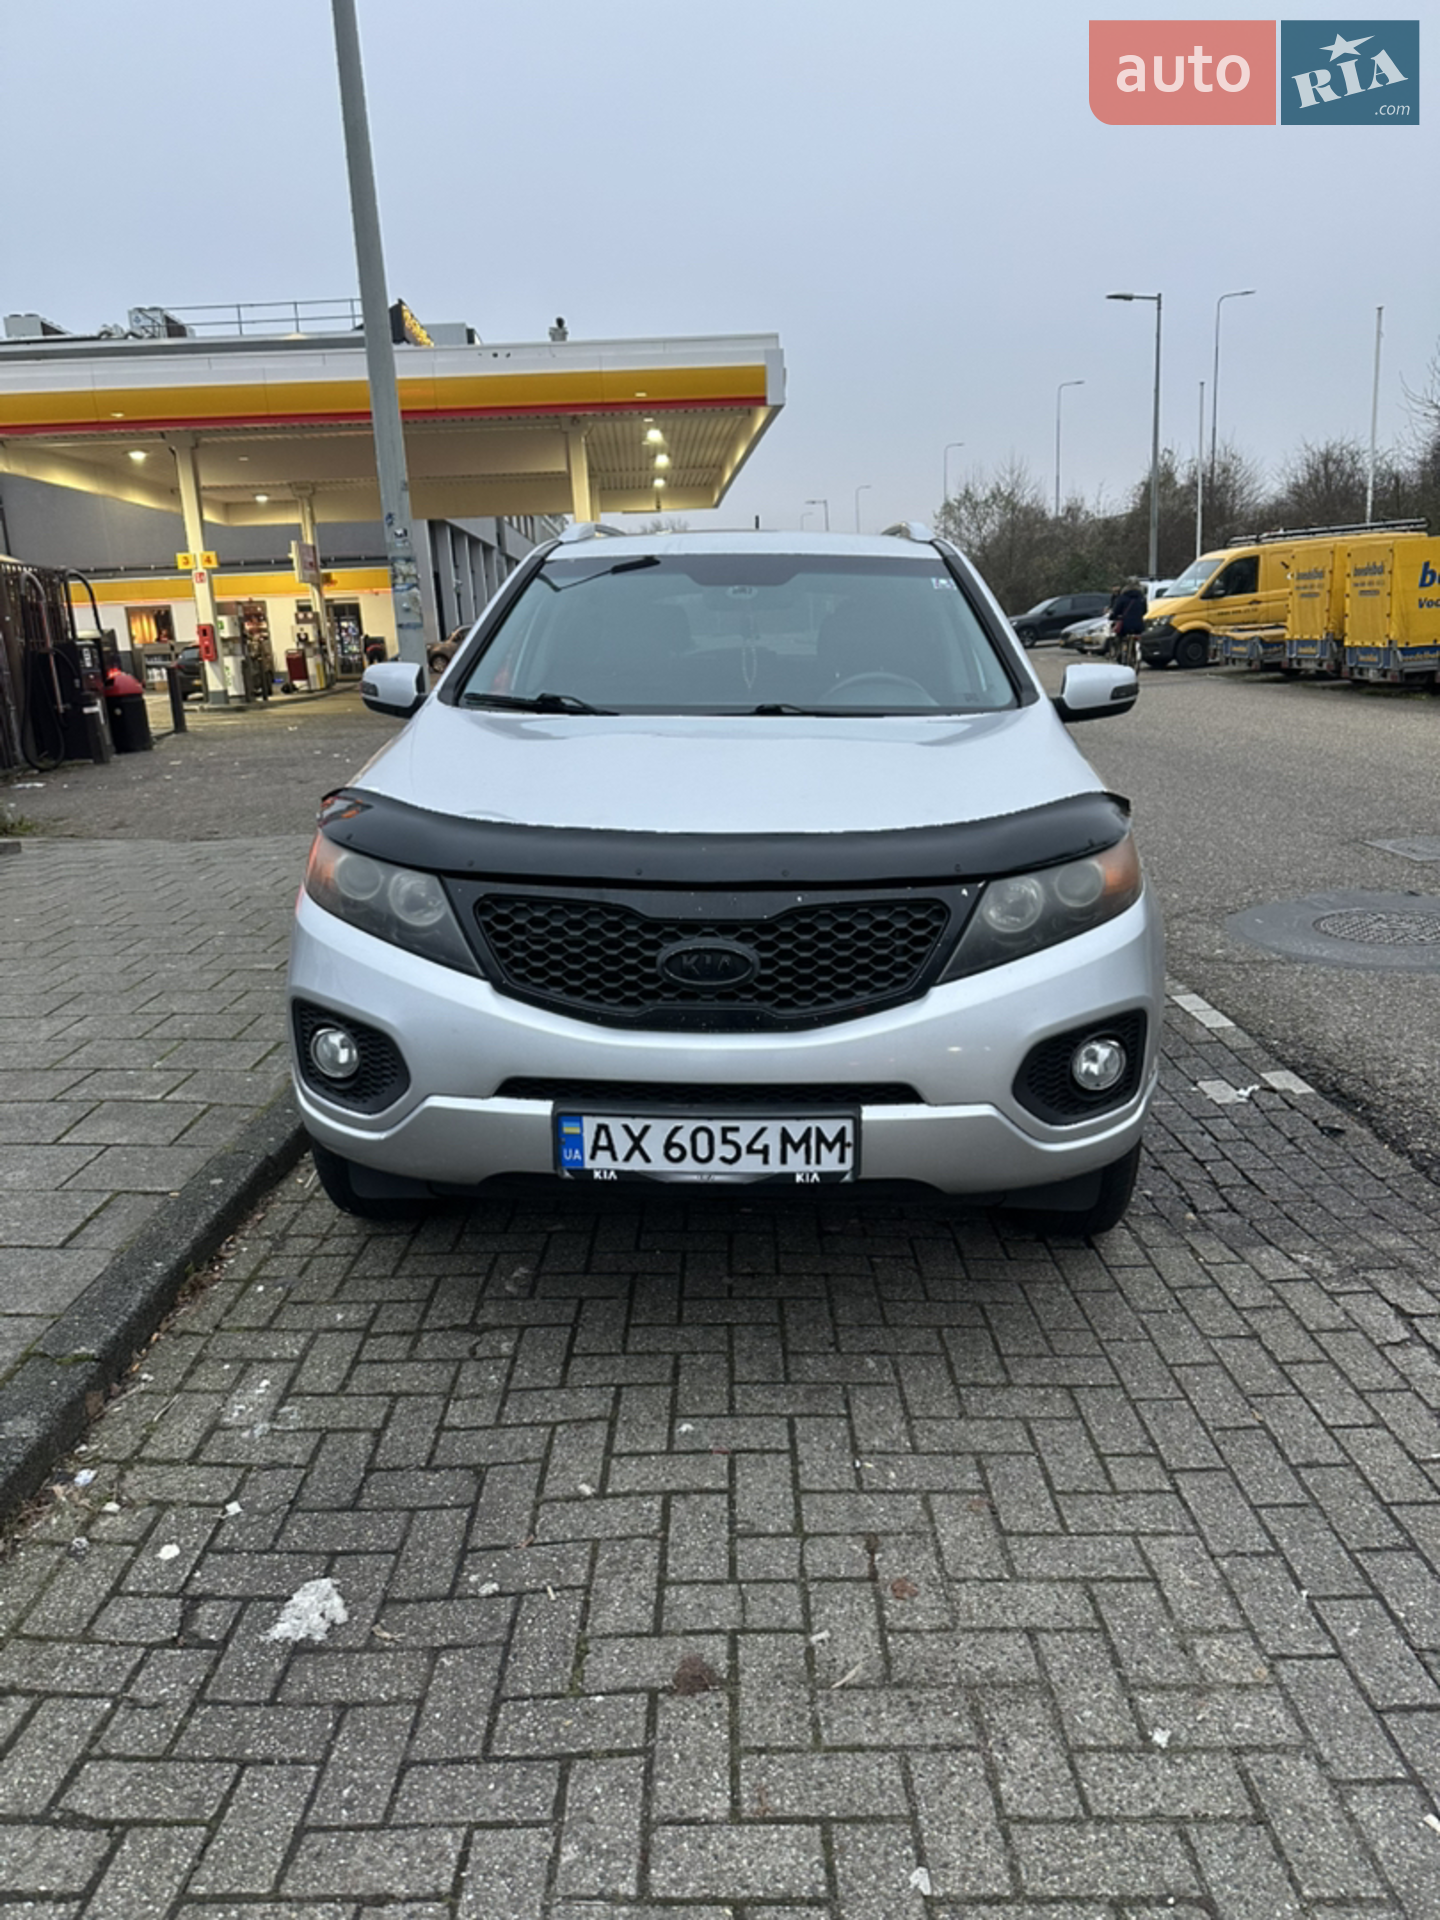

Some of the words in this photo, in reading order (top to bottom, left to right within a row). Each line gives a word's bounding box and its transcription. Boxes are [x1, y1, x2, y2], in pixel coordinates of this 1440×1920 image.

[680, 953, 732, 976] KIA
[589, 1123, 652, 1164] AX
[663, 1125, 770, 1165] 6054
[780, 1126, 847, 1166] MM
[563, 1149, 582, 1161] UA
[593, 1169, 618, 1181] KIA
[795, 1173, 821, 1184] KIA
